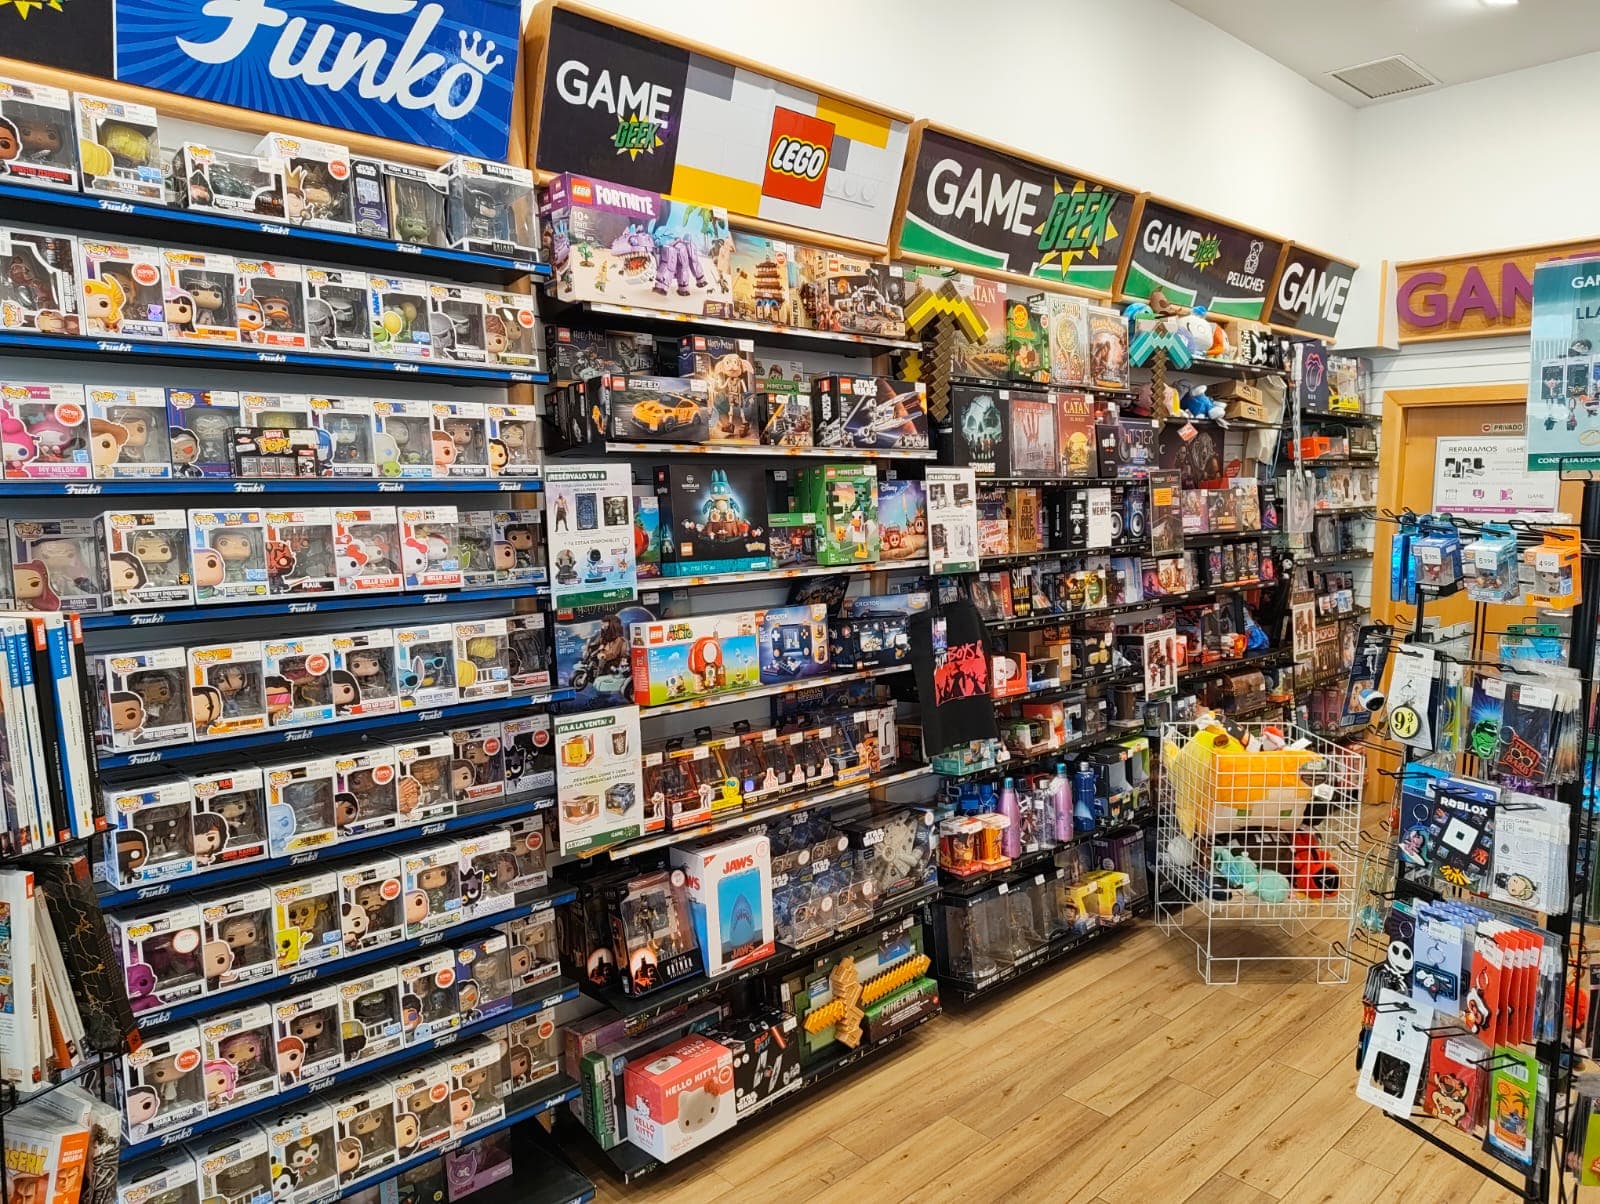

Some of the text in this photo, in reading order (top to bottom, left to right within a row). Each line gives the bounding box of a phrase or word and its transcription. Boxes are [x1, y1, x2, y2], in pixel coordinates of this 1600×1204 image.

[176, 0, 485, 121] Funko
[556, 60, 673, 130] GAME
[615, 121, 659, 150] GEEK
[771, 140, 826, 179] LEGO
[99, 200, 134, 213] Funko
[572, 184, 656, 216] LEGO FORTNITE
[926, 158, 1119, 251] GAME GEEK
[260, 223, 290, 235] Funko
[1143, 220, 1200, 262] GAME
[1226, 271, 1266, 290] PELUCHES
[973, 286, 996, 304] TAN
[1278, 262, 1351, 323] GAME
[97, 341, 133, 352] Funko
[257, 352, 287, 363] Funko
[628, 379, 661, 390] SPEED
[853, 378, 878, 388] STAR
[853, 386, 878, 397] WARS
[1064, 401, 1090, 415] CATAN
[1493, 423, 1523, 431] PRIVADO
[65, 483, 102, 495] Funko
[233, 482, 265, 493] Funko
[880, 482, 898, 493] Disney
[288, 602, 317, 613] Funko
[130, 614, 166, 625] Funko
[667, 629, 694, 641] MARIO
[669, 624, 690, 632] SUPER
[948, 644, 976, 662] BOYS
[283, 730, 314, 742] Funko
[128, 752, 162, 765] Funko
[1440, 796, 1488, 817] ROBLOX
[865, 828, 885, 839] STAR
[863, 836, 885, 847] WARS
[290, 851, 319, 865] Funko
[722, 855, 754, 874] JAWS
[686, 875, 700, 891] WS
[137, 885, 171, 899] Funko
[289, 969, 319, 985] Funko
[881, 988, 924, 1016] MINECRAFT
[138, 1012, 171, 1029] Funko
[308, 1077, 337, 1093] Funko
[665, 1064, 718, 1098] HELLO KITTY
[633, 1115, 655, 1131] HELLO
[160, 1127, 193, 1146] Funko
[635, 1125, 654, 1139] KITTY
[5, 1149, 47, 1176] SERK
[315, 1190, 343, 1204] Funko
